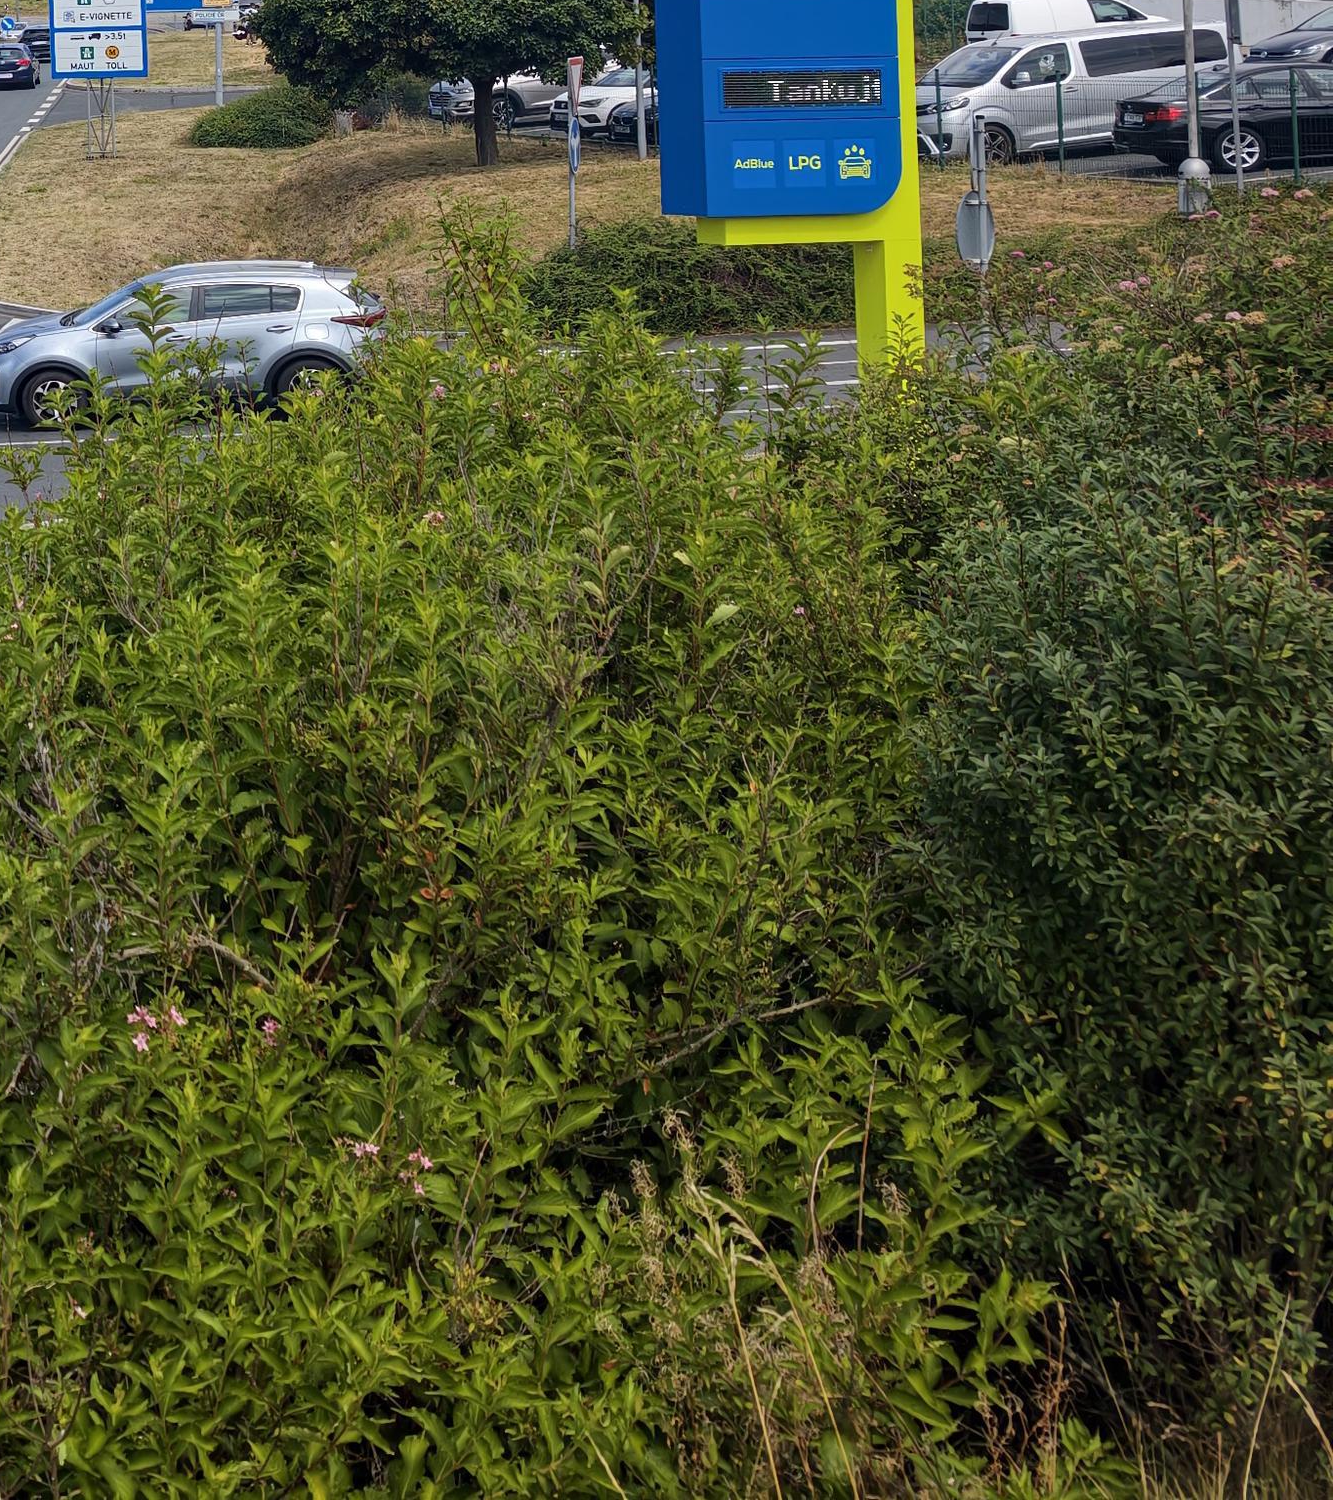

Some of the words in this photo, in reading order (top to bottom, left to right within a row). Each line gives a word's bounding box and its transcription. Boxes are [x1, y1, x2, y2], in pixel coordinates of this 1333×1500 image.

[80, 11, 132, 21] E-VIGNETTE
[734, 158, 774, 169] AdBlue
[789, 156, 821, 170] LPG
